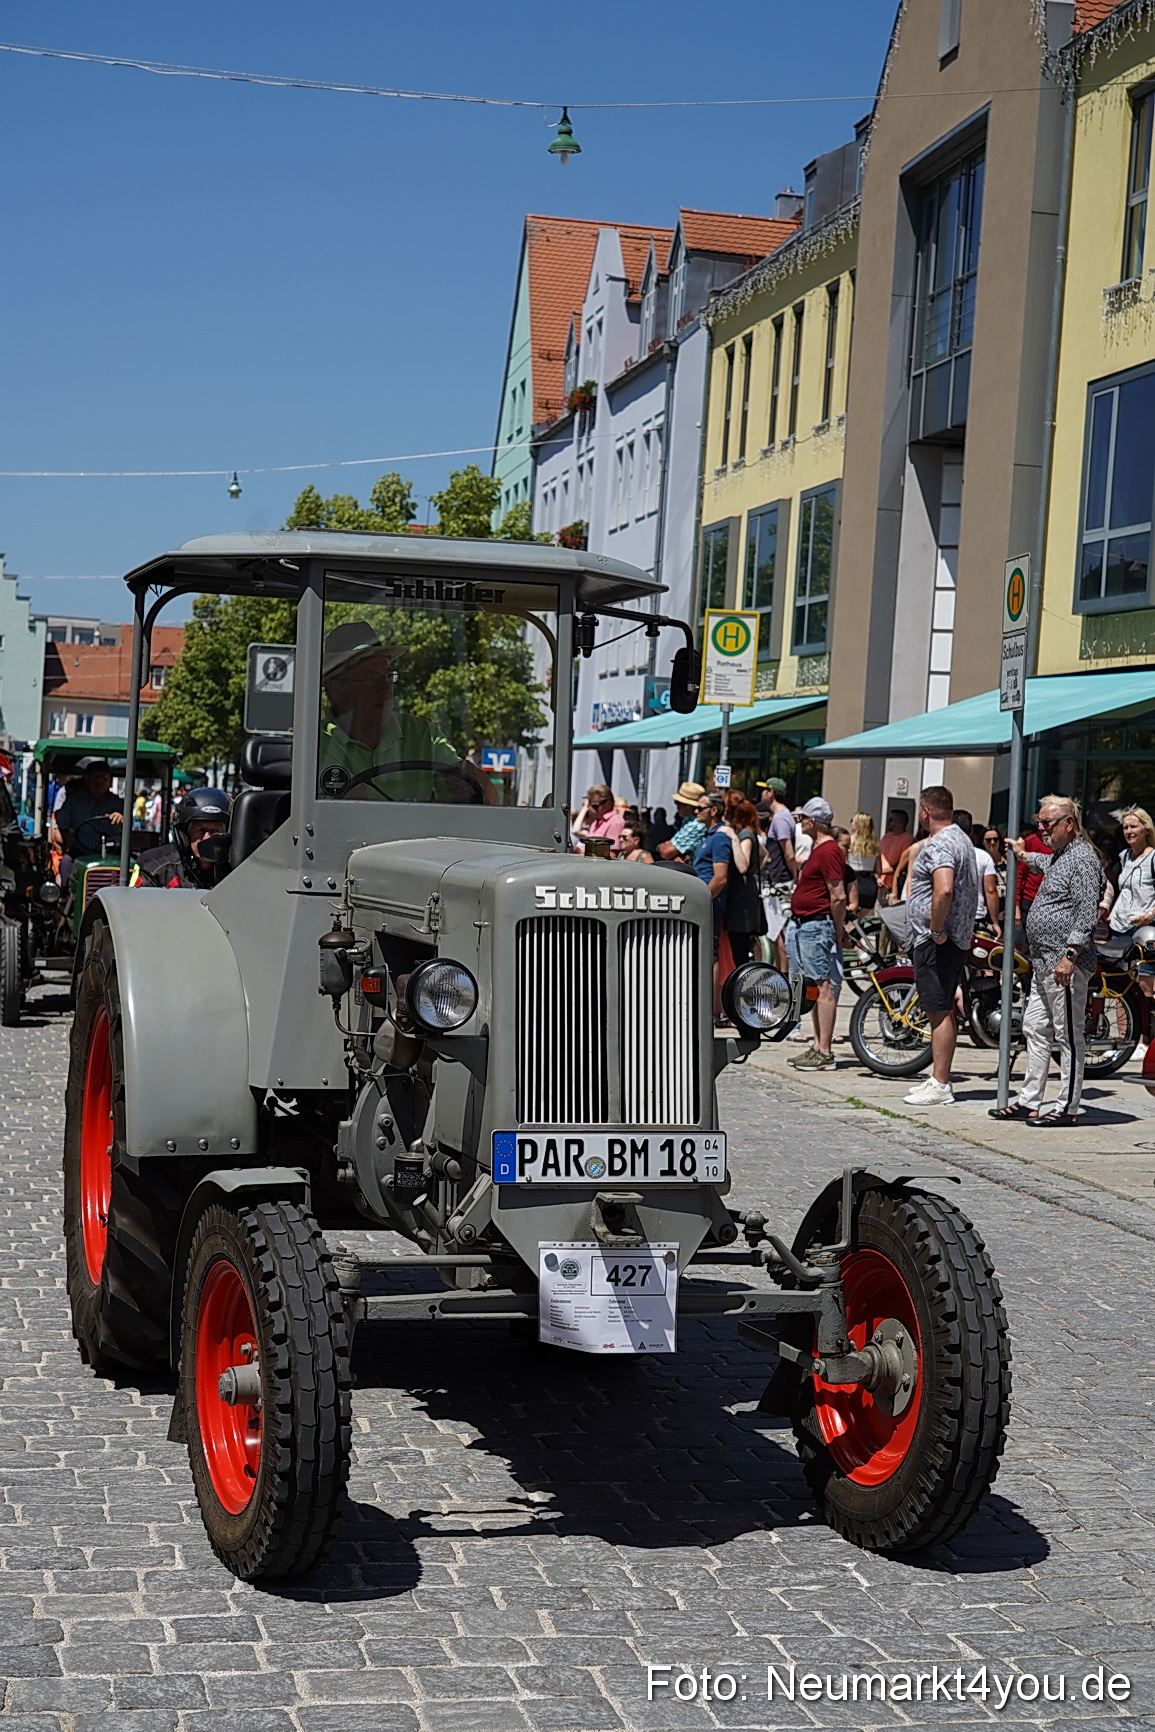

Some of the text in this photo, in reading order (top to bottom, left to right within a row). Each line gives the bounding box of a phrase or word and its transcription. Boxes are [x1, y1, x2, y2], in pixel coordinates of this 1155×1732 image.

[384, 578, 506, 603] Schlüter
[723, 625, 740, 648] H
[1003, 641, 1024, 661] Schulbus
[716, 660, 742, 668] Rathaus
[535, 885, 685, 914] Schlüter
[704, 1138, 718, 1150] 04
[517, 1138, 697, 1177] PAR BM 18
[500, 1163, 509, 1175] D
[705, 1165, 718, 1177] 10
[606, 1264, 653, 1287] 427
